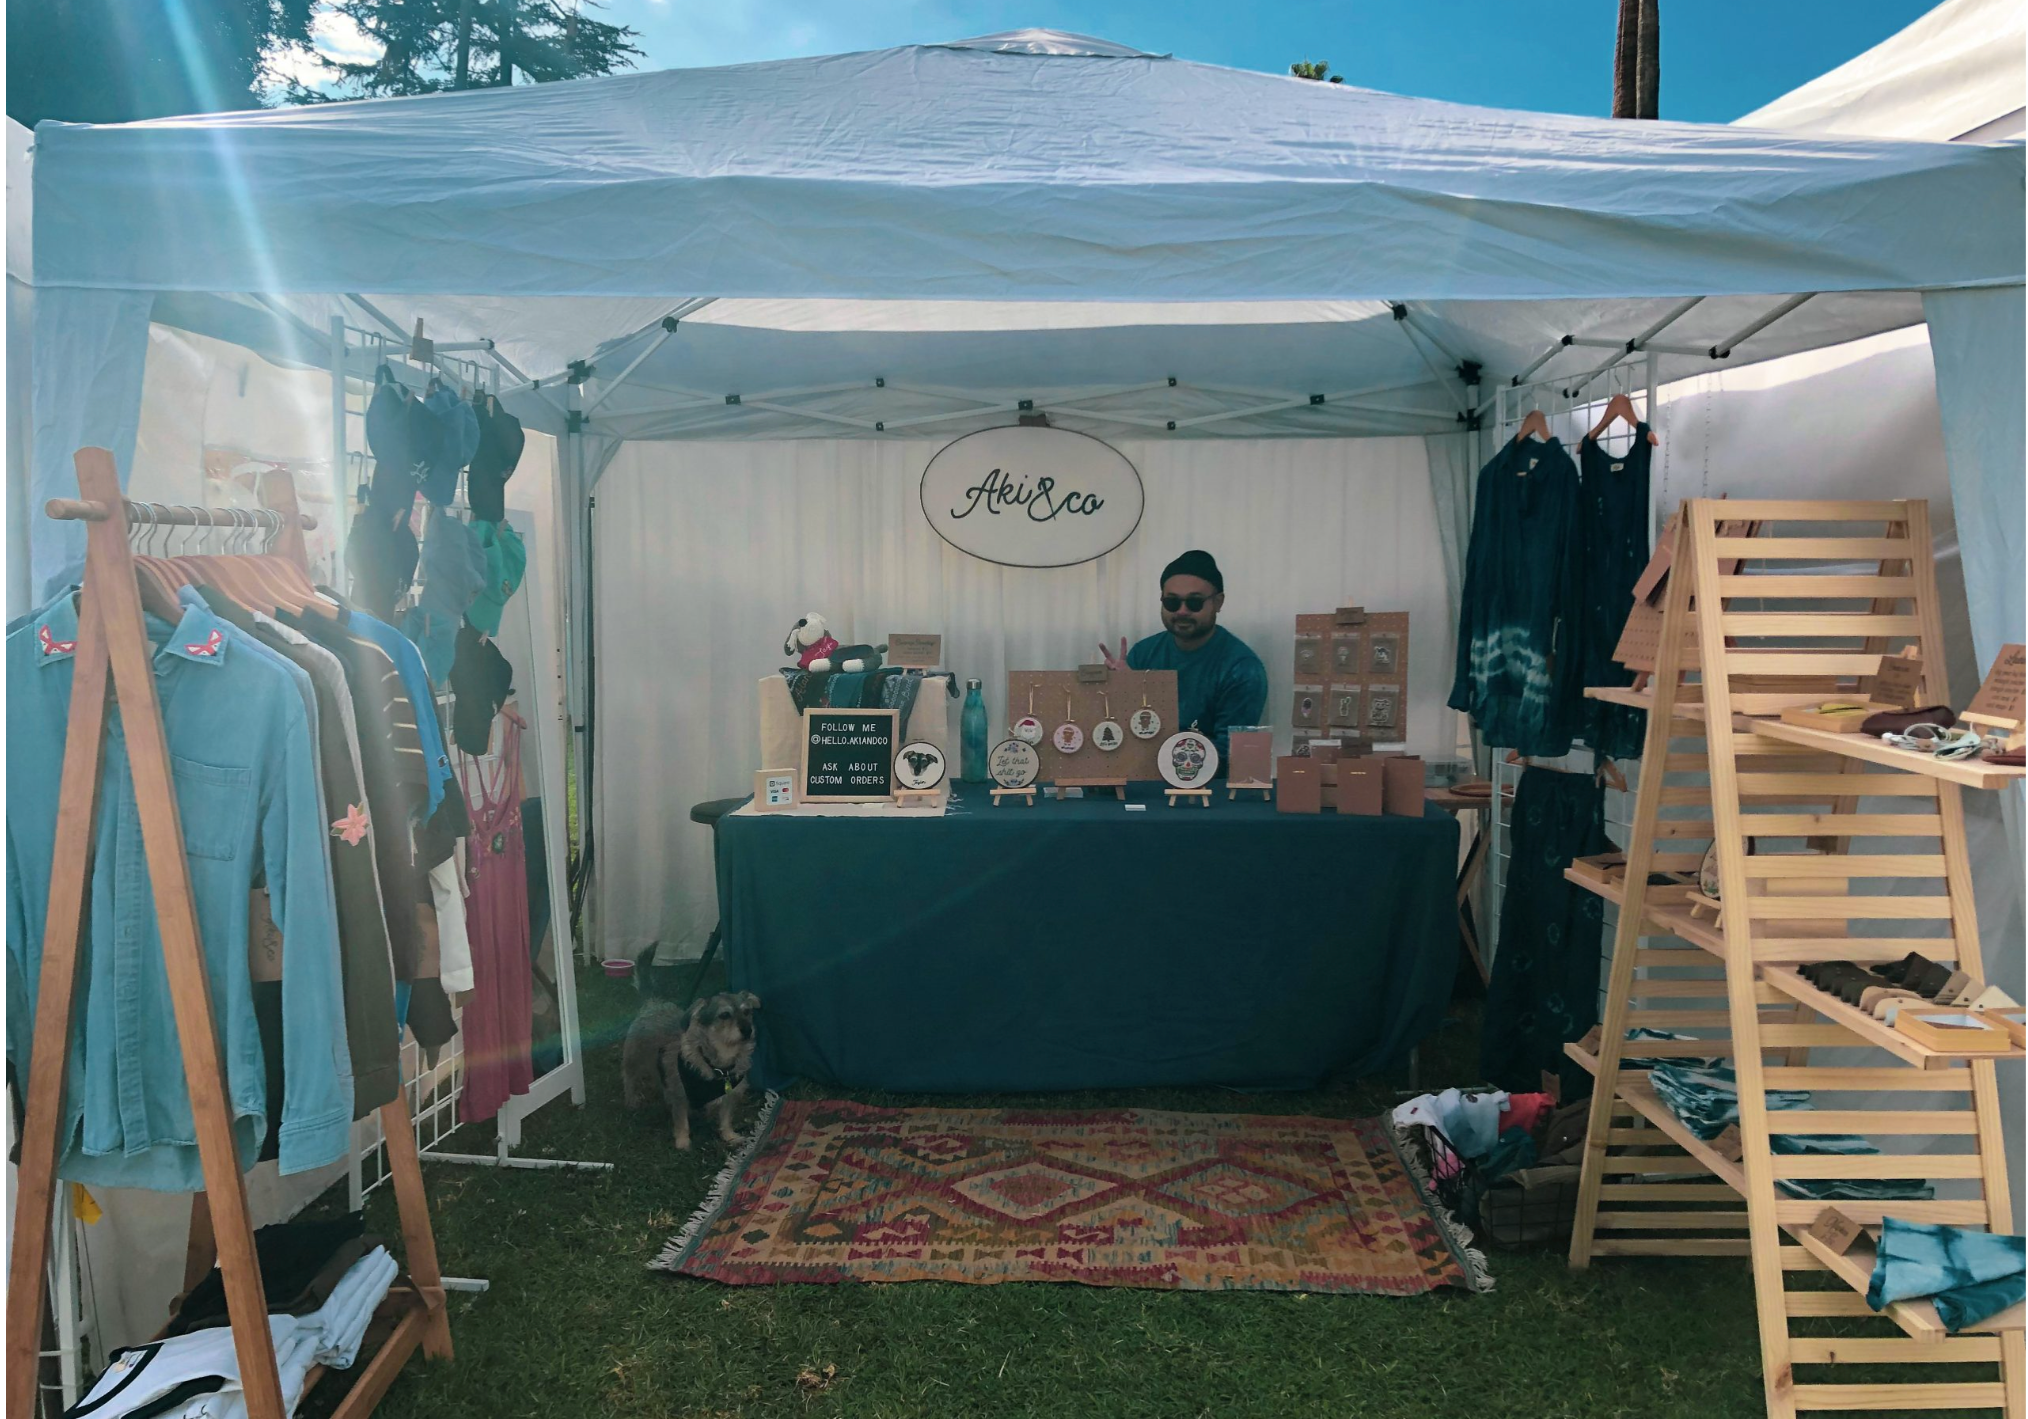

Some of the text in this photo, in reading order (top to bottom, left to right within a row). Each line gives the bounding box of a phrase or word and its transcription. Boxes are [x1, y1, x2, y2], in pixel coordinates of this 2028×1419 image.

[950, 468, 1105, 522] Aki&co
[821, 723, 876, 732] FOLLOW ME
[810, 734, 888, 745] @HELLO.AKIANDCO
[996, 755, 1030, 767] Let that
[822, 763, 878, 771] ASK ABOUT
[996, 767, 1027, 778] shit go
[810, 775, 885, 785] CUSTOM ORDERS
